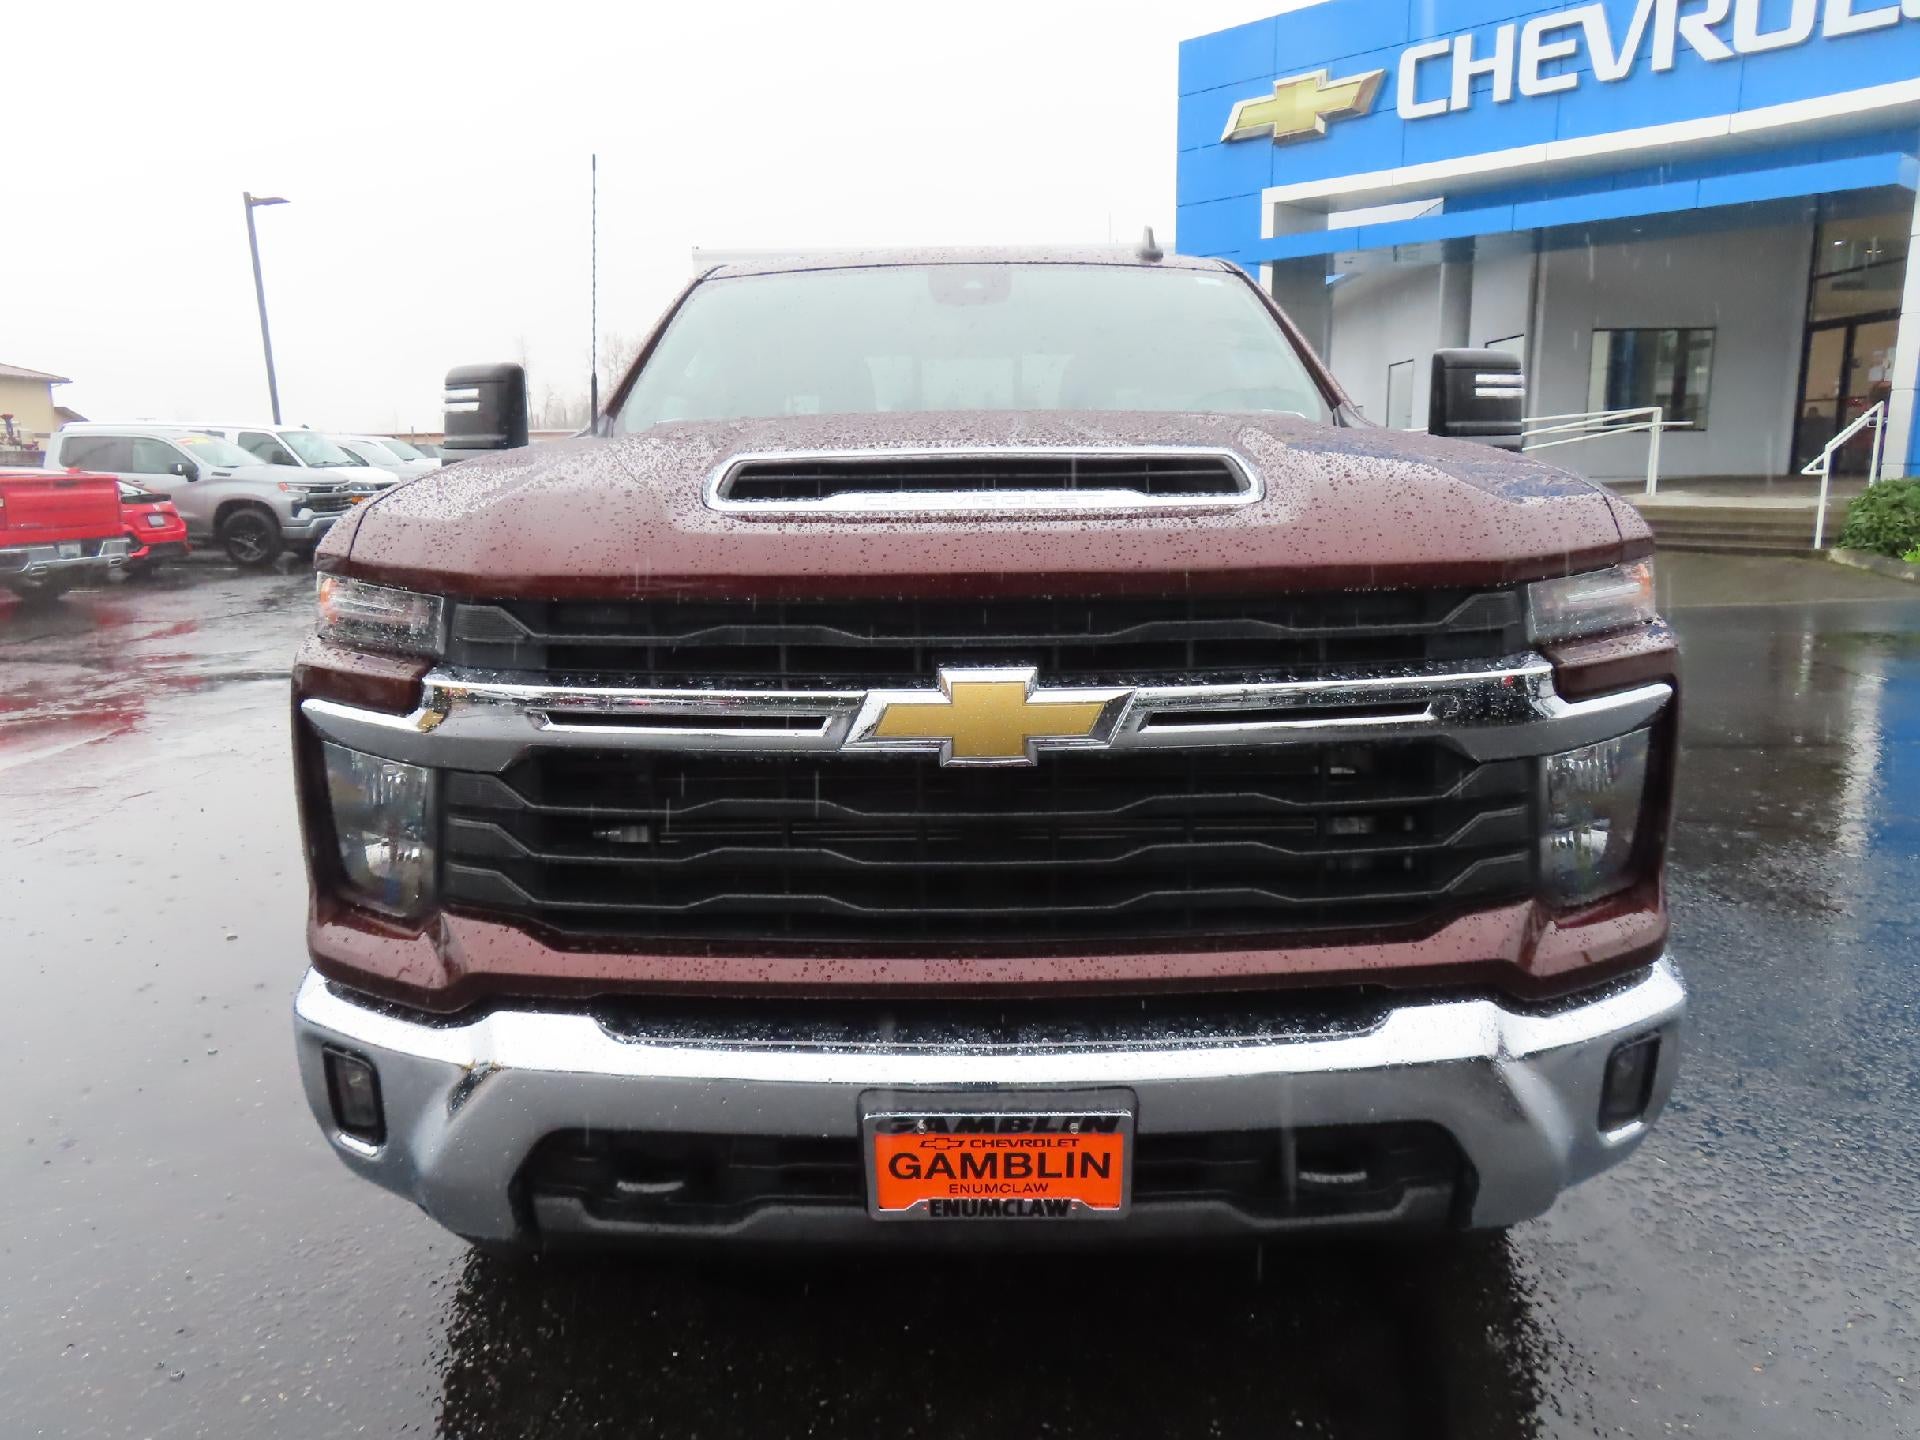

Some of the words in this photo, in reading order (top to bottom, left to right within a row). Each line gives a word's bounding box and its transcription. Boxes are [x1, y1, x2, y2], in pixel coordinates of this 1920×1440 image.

[1397, 0, 1920, 119] CHEVROL
[864, 494, 1104, 507] CHEVROLET
[875, 1115, 1121, 1134] GAMBLIN
[969, 1138, 1080, 1149] CHEVROLET
[888, 1151, 1111, 1180] GAMBLIN
[948, 1182, 1049, 1194] ENUMCLAW
[929, 1198, 1073, 1218] ENUMCLAW
